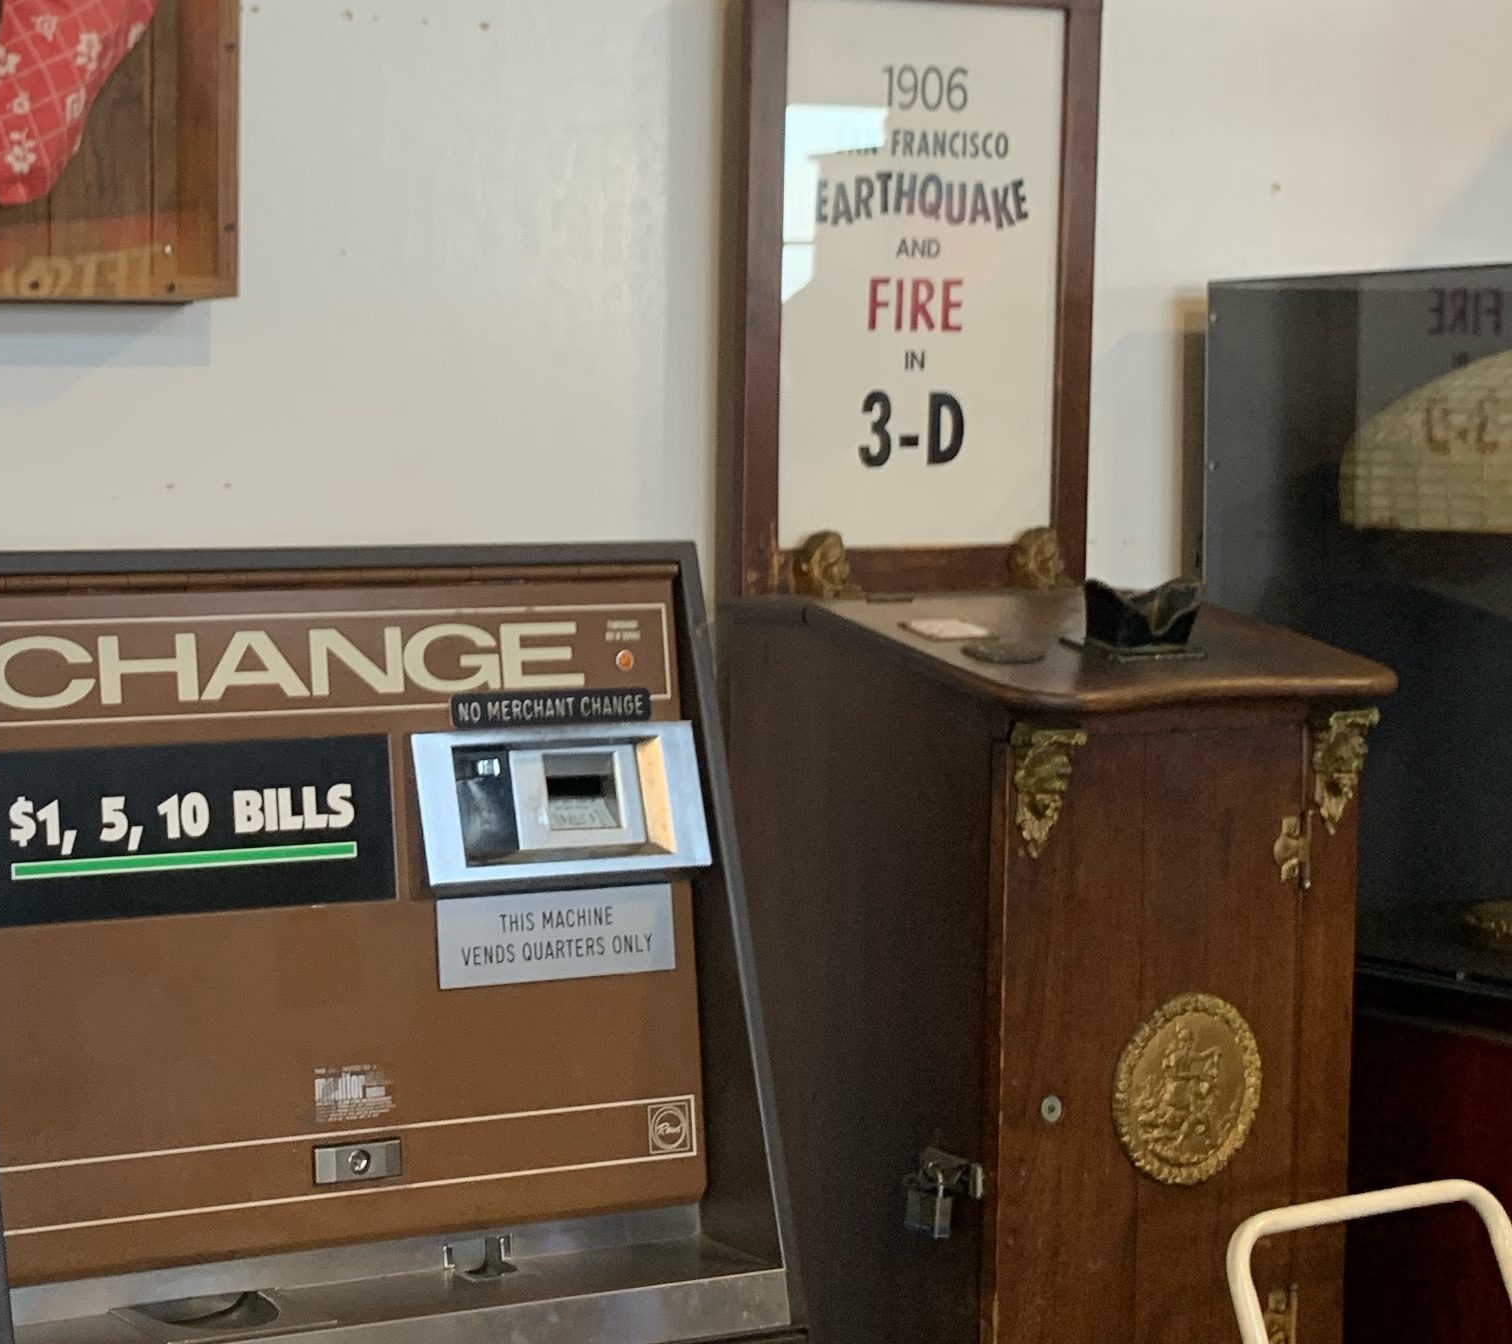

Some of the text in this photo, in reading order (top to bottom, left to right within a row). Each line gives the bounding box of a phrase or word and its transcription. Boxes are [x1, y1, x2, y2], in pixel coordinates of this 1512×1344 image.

[882, 64, 969, 112] 1906
[891, 128, 1010, 160] FRANCISCO
[815, 169, 1030, 231] EARTHQUAKE
[896, 238, 940, 259] AND
[867, 276, 964, 333] FIRE
[904, 351, 926, 370] IN
[858, 390, 966, 468] 3-D
[458, 694, 644, 723] NO MERCHANT CHANGE
[9, 783, 355, 856] $1, 5, 10 BILLS
[499, 905, 614, 933] THIS MACHINE
[461, 932, 653, 967] VENDS QUARTERS ONLY
